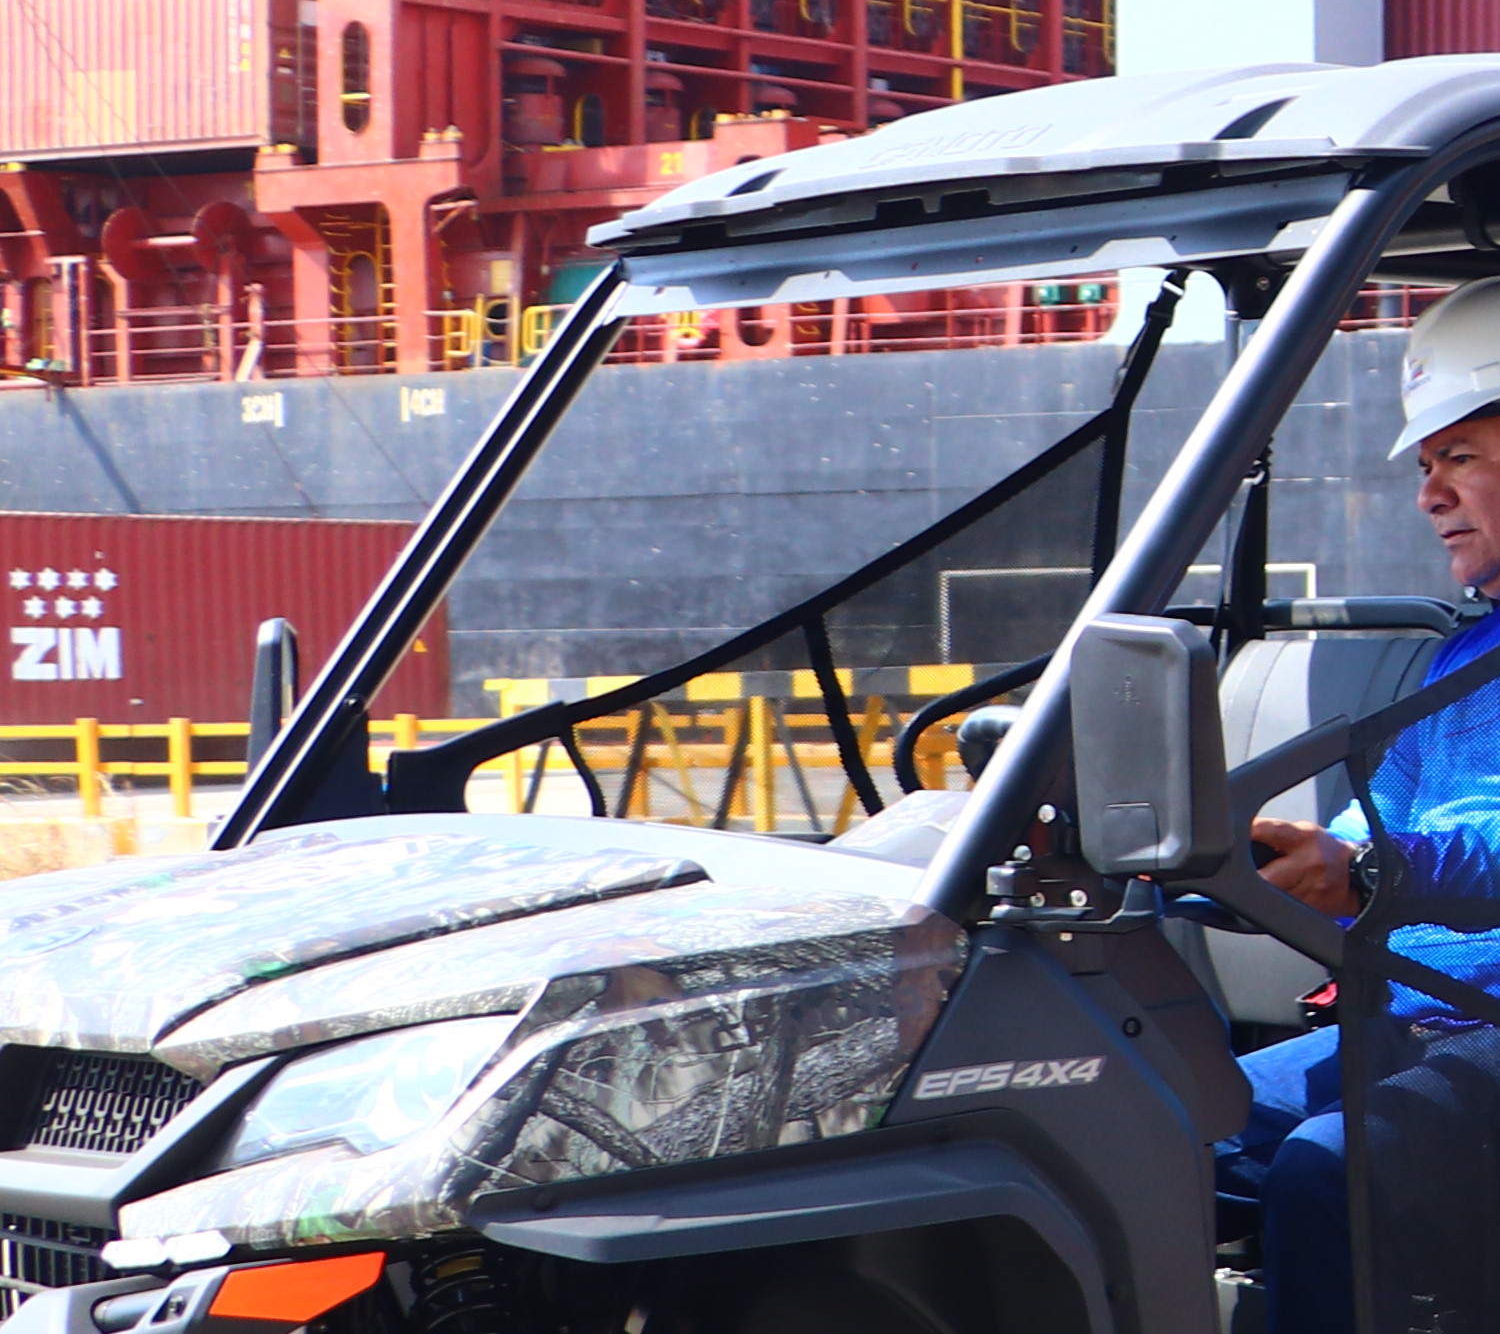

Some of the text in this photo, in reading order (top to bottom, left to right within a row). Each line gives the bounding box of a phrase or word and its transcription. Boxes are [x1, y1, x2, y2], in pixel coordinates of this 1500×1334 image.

[660, 151, 682, 175] 21
[10, 626, 123, 681] ZIM
[913, 1058, 1102, 1100] EPS 4X4
